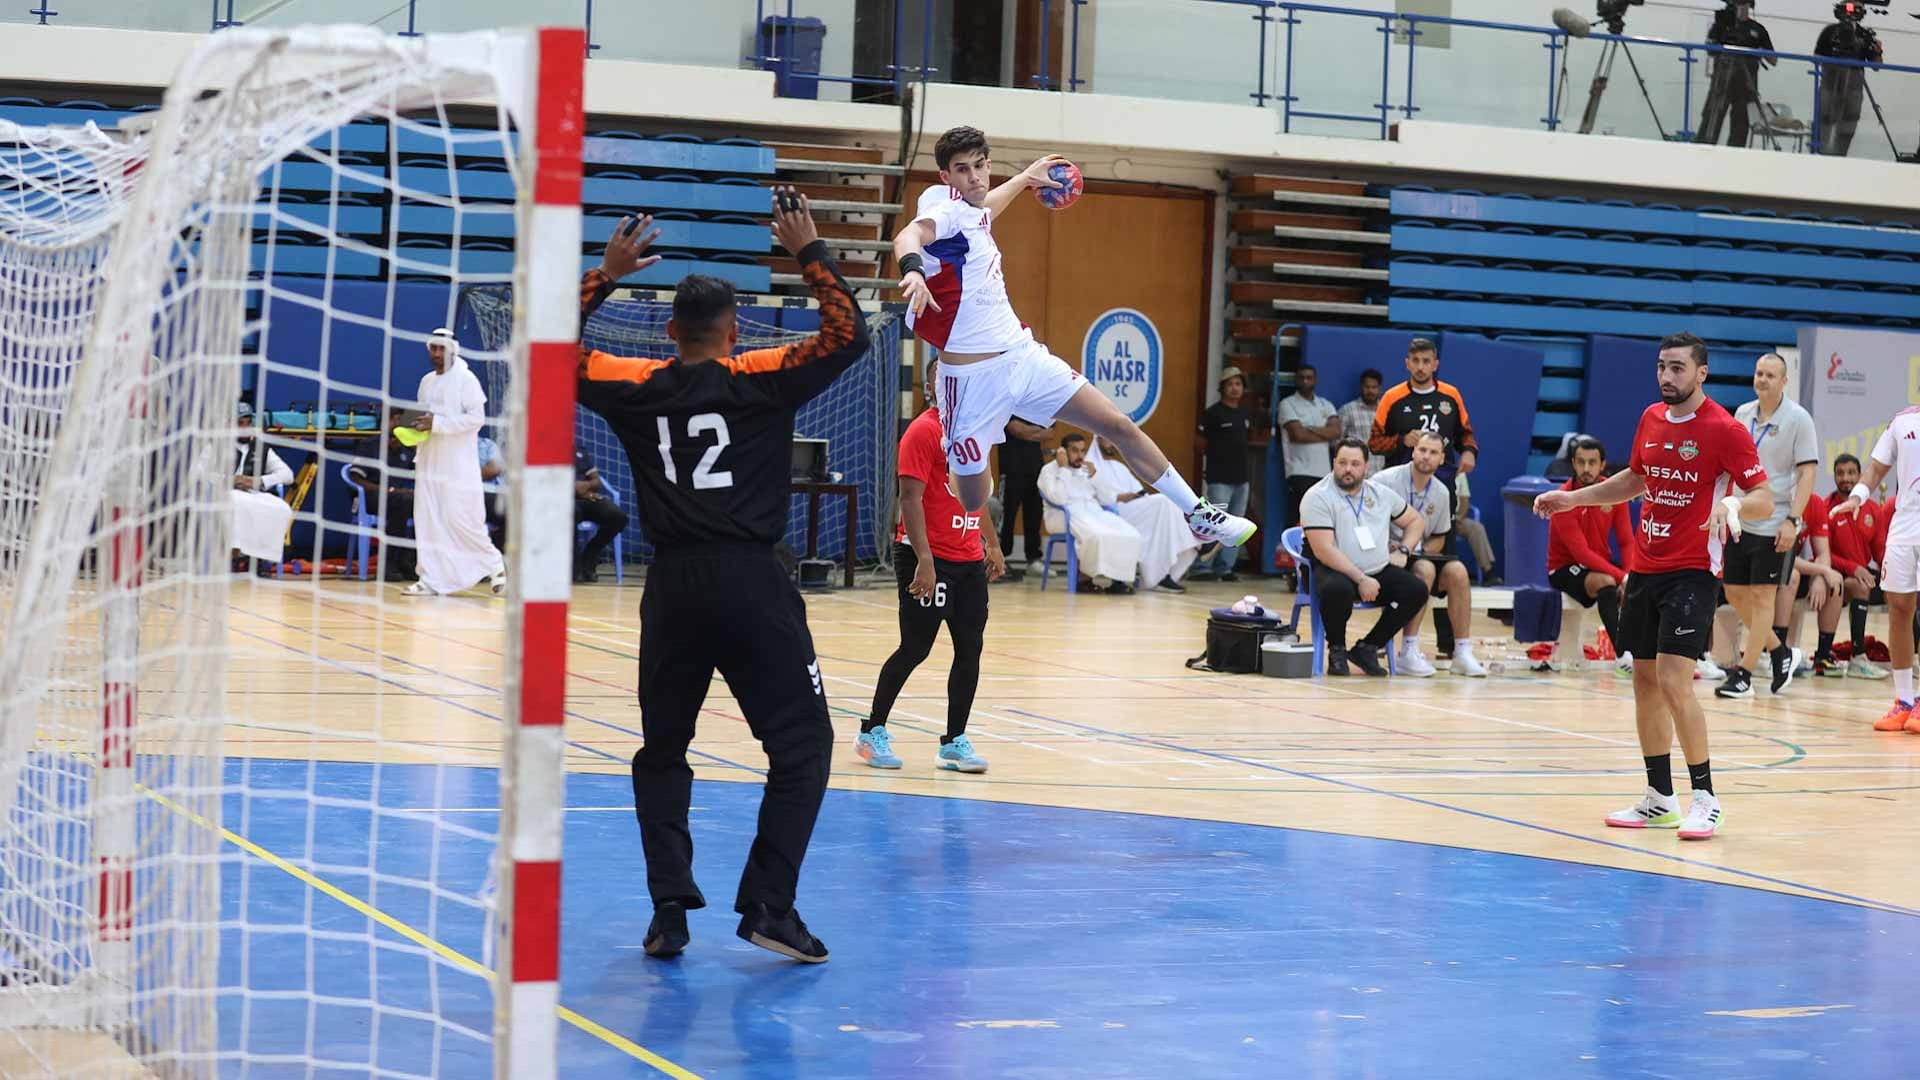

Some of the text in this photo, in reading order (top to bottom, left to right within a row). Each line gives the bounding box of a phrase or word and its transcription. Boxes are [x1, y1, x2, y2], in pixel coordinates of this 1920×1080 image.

[1114, 341, 1132, 358] AL
[1098, 360, 1145, 382] NASR
[1114, 384, 1129, 398] SC
[1419, 414, 1440, 432] 24
[656, 412, 734, 490] 12
[953, 437, 981, 465] 90
